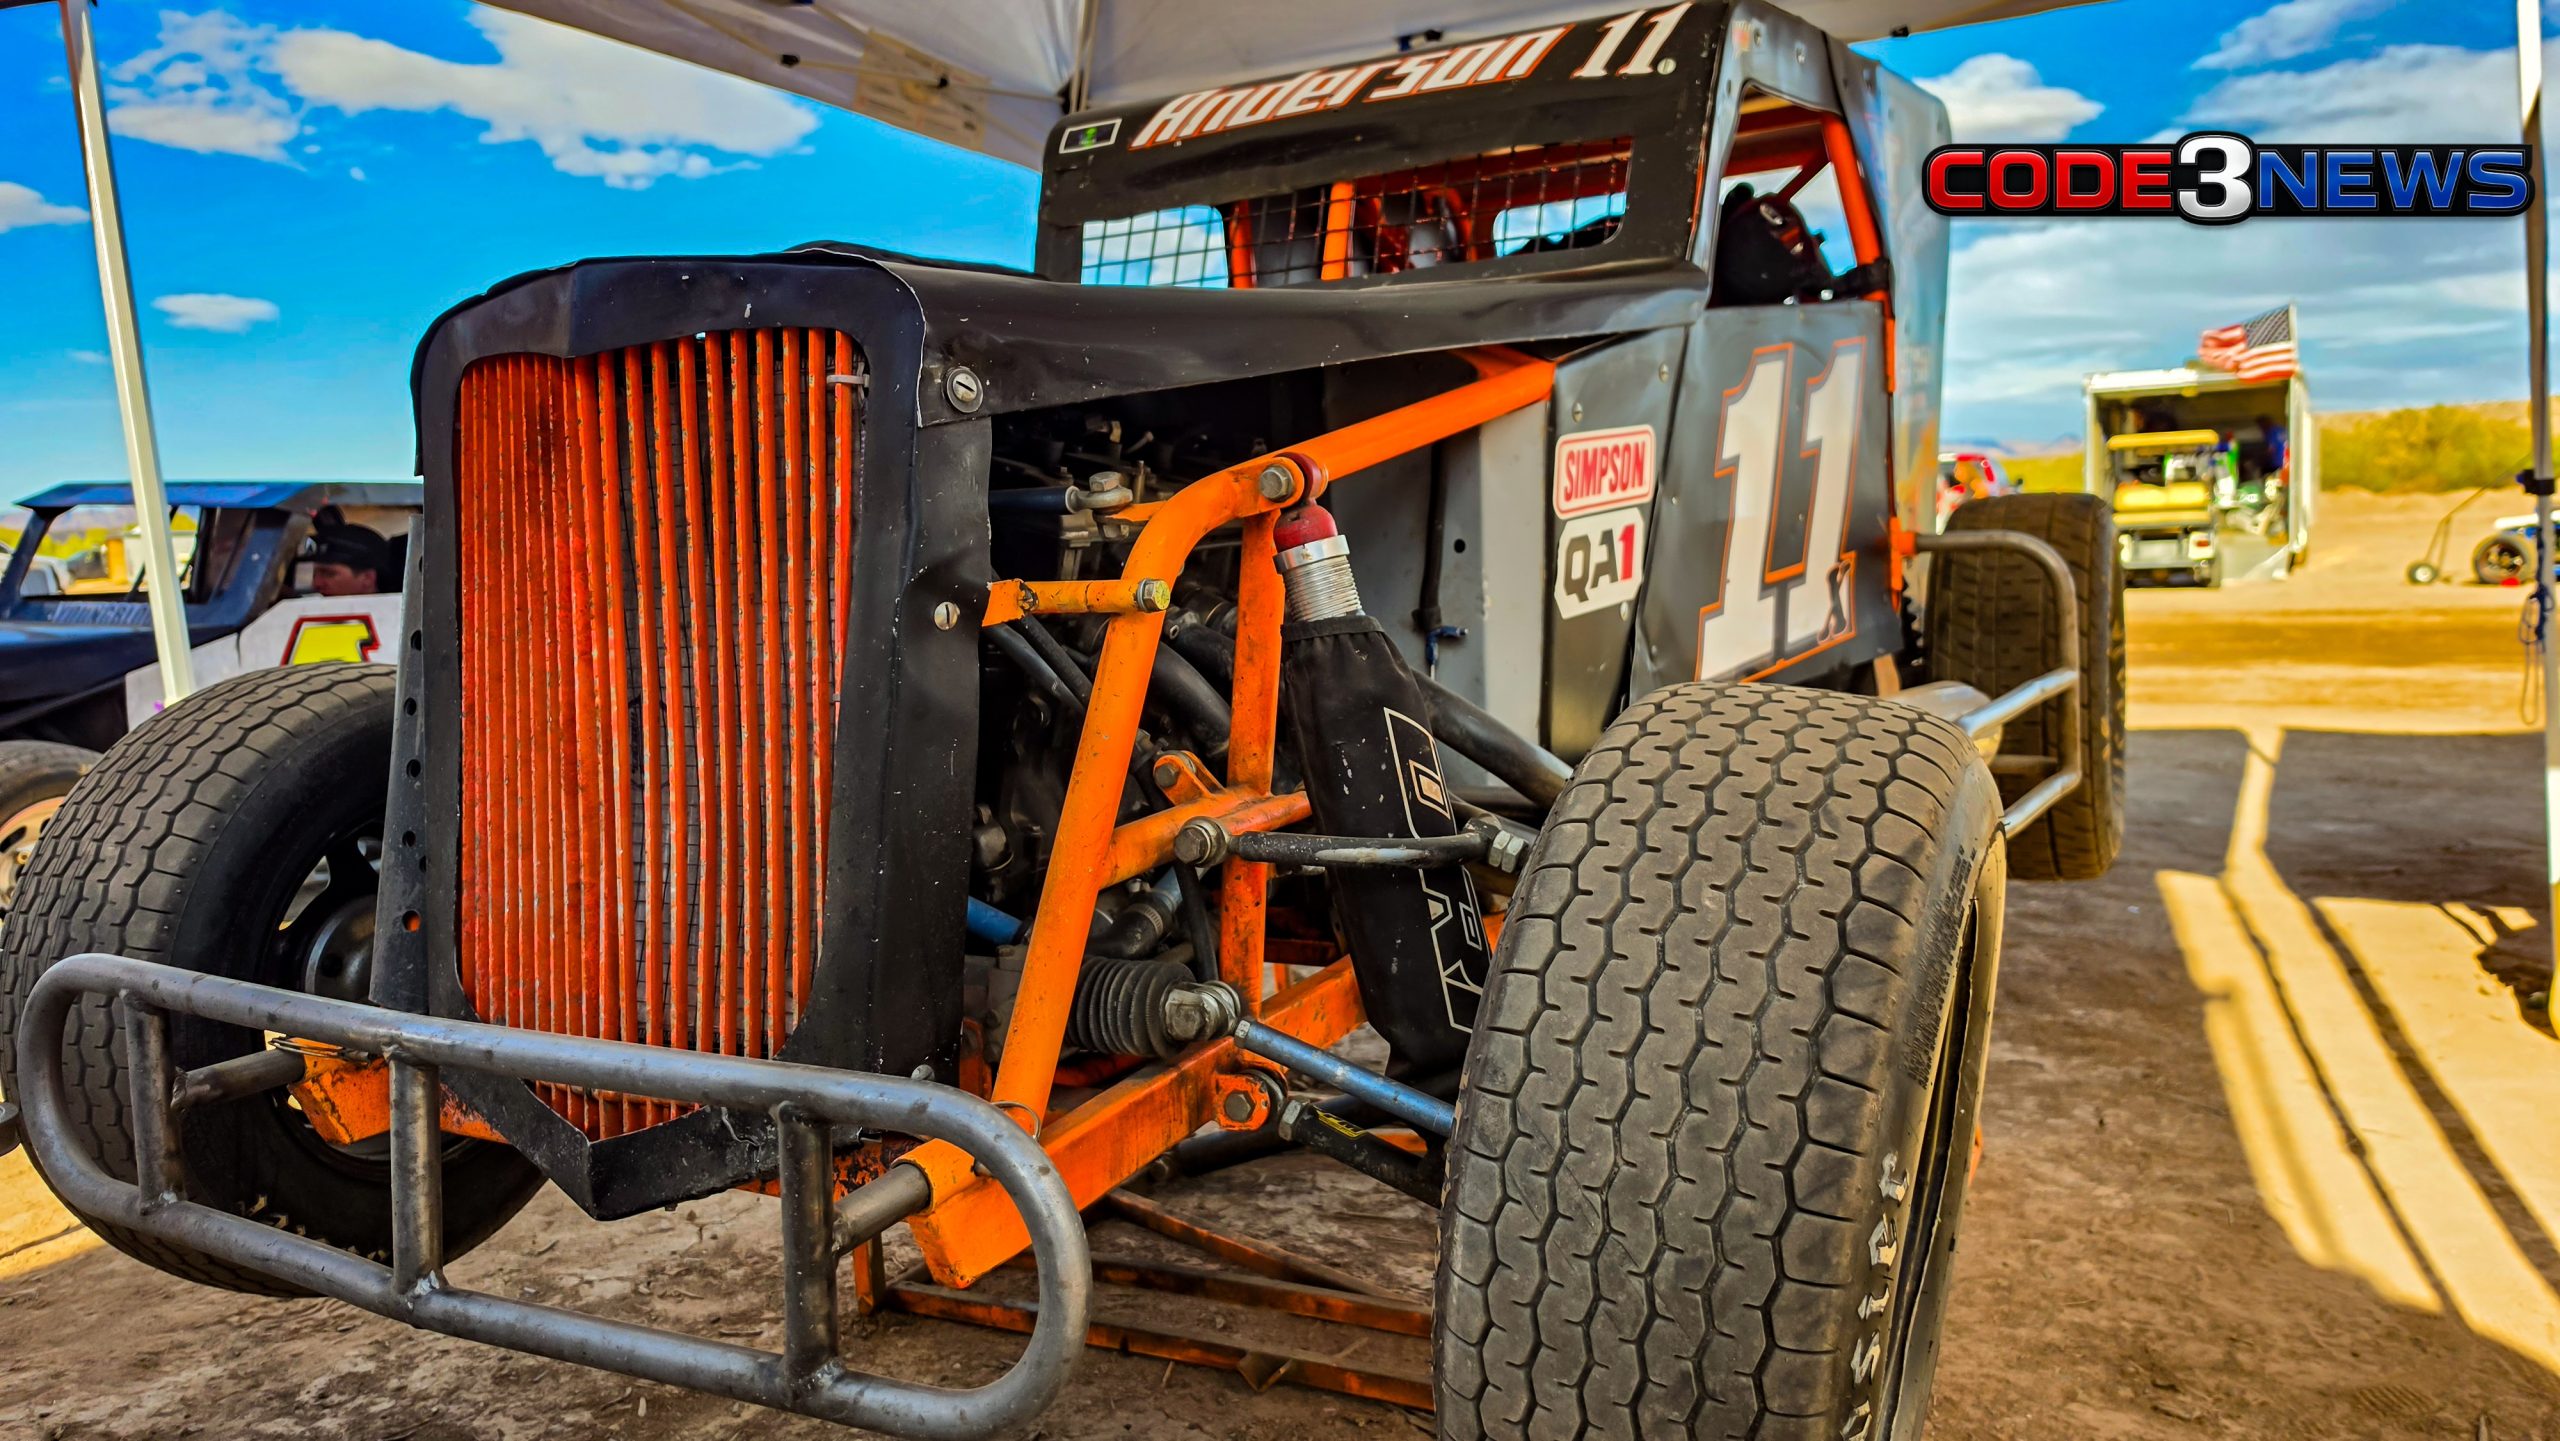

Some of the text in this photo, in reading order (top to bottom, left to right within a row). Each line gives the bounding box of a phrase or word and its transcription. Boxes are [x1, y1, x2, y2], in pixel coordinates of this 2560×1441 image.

[1130, 25, 1569, 149] Anderson
[1563, 440, 1646, 502] SIMPSON
[1562, 523, 1637, 603] QA1
